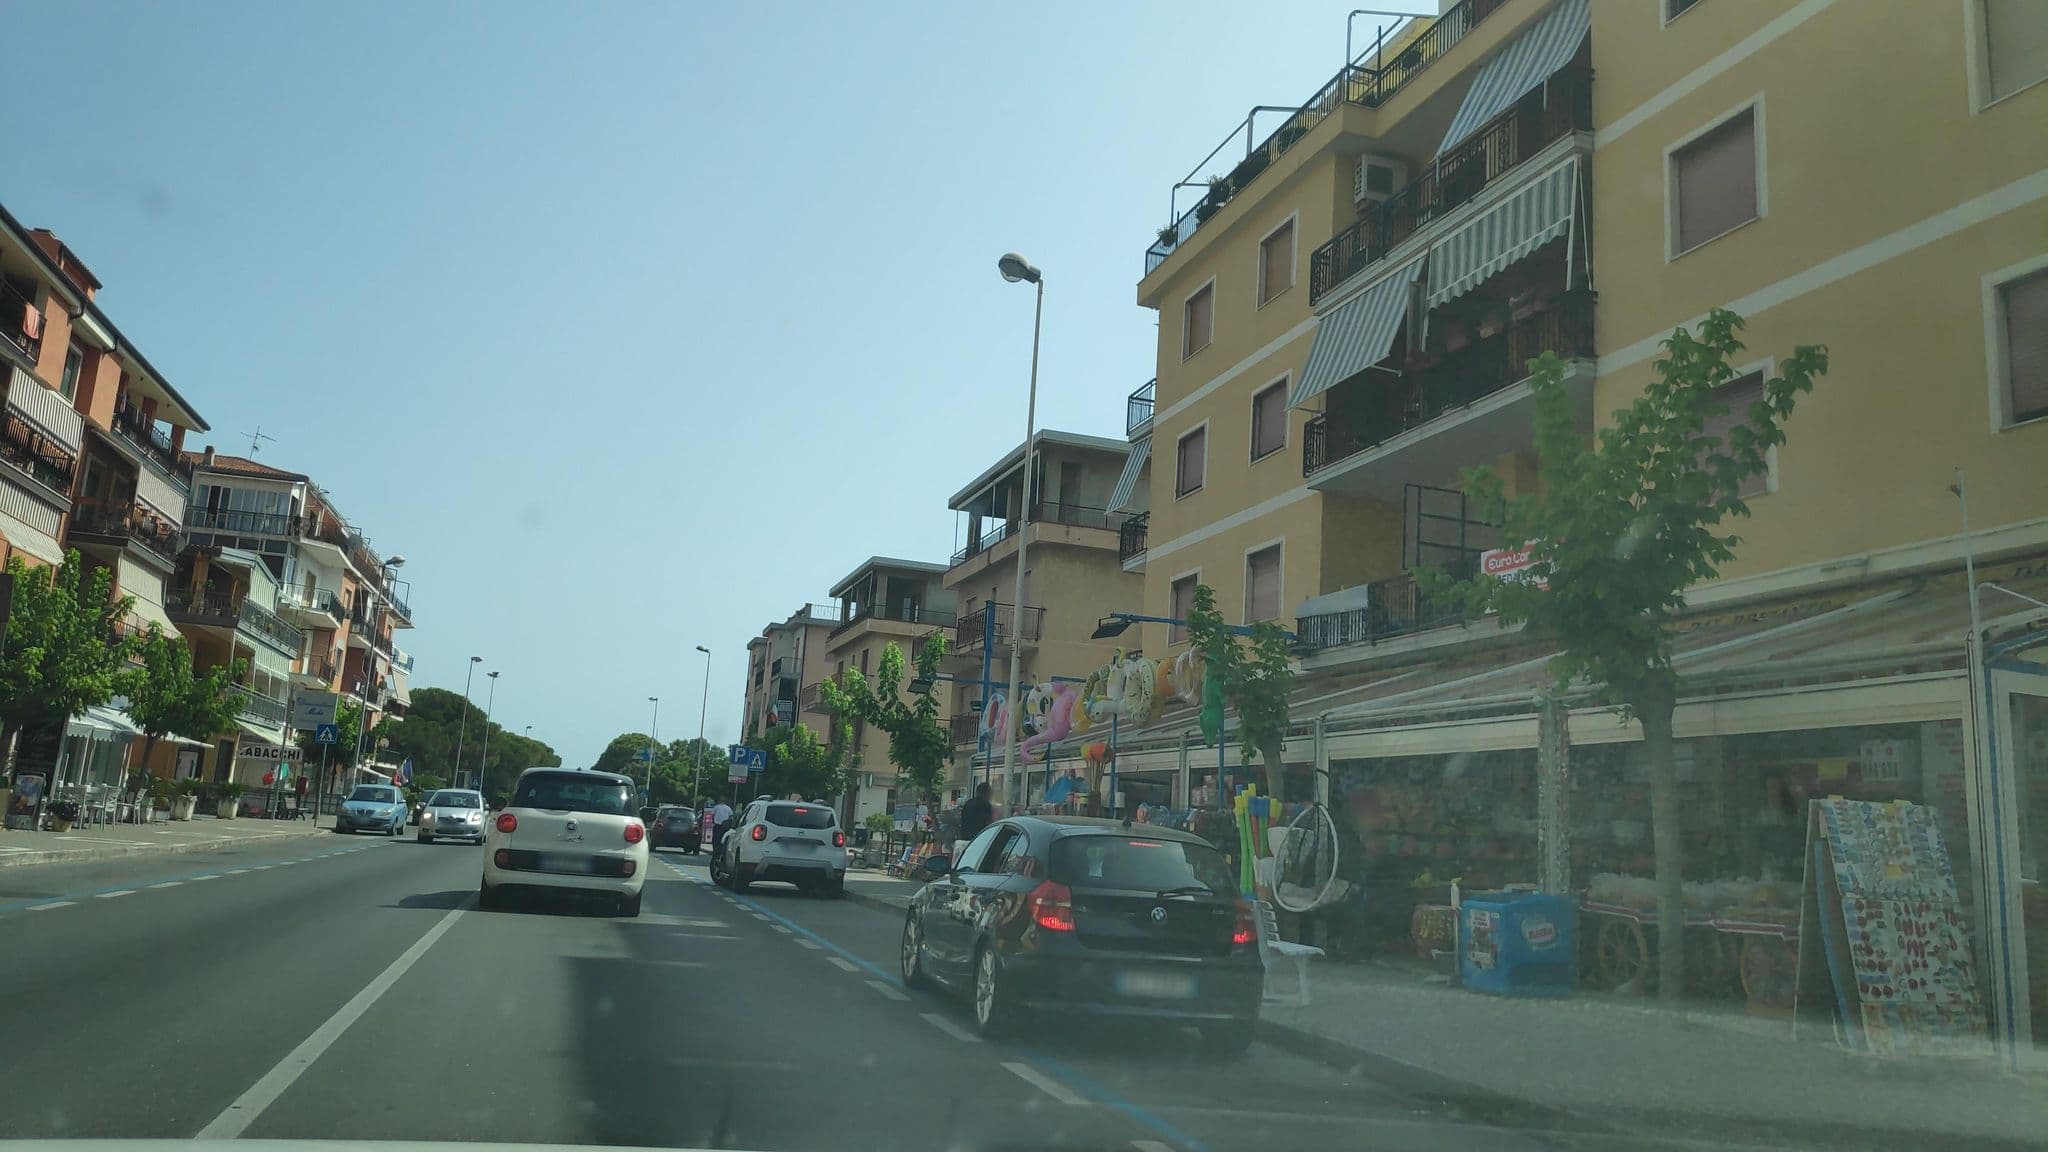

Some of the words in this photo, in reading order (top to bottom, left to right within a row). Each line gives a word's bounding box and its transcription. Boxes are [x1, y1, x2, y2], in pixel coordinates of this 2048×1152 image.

[1488, 556, 1512, 570] Euro
[240, 746, 300, 761] ABACCHI
[734, 747, 746, 762] P
